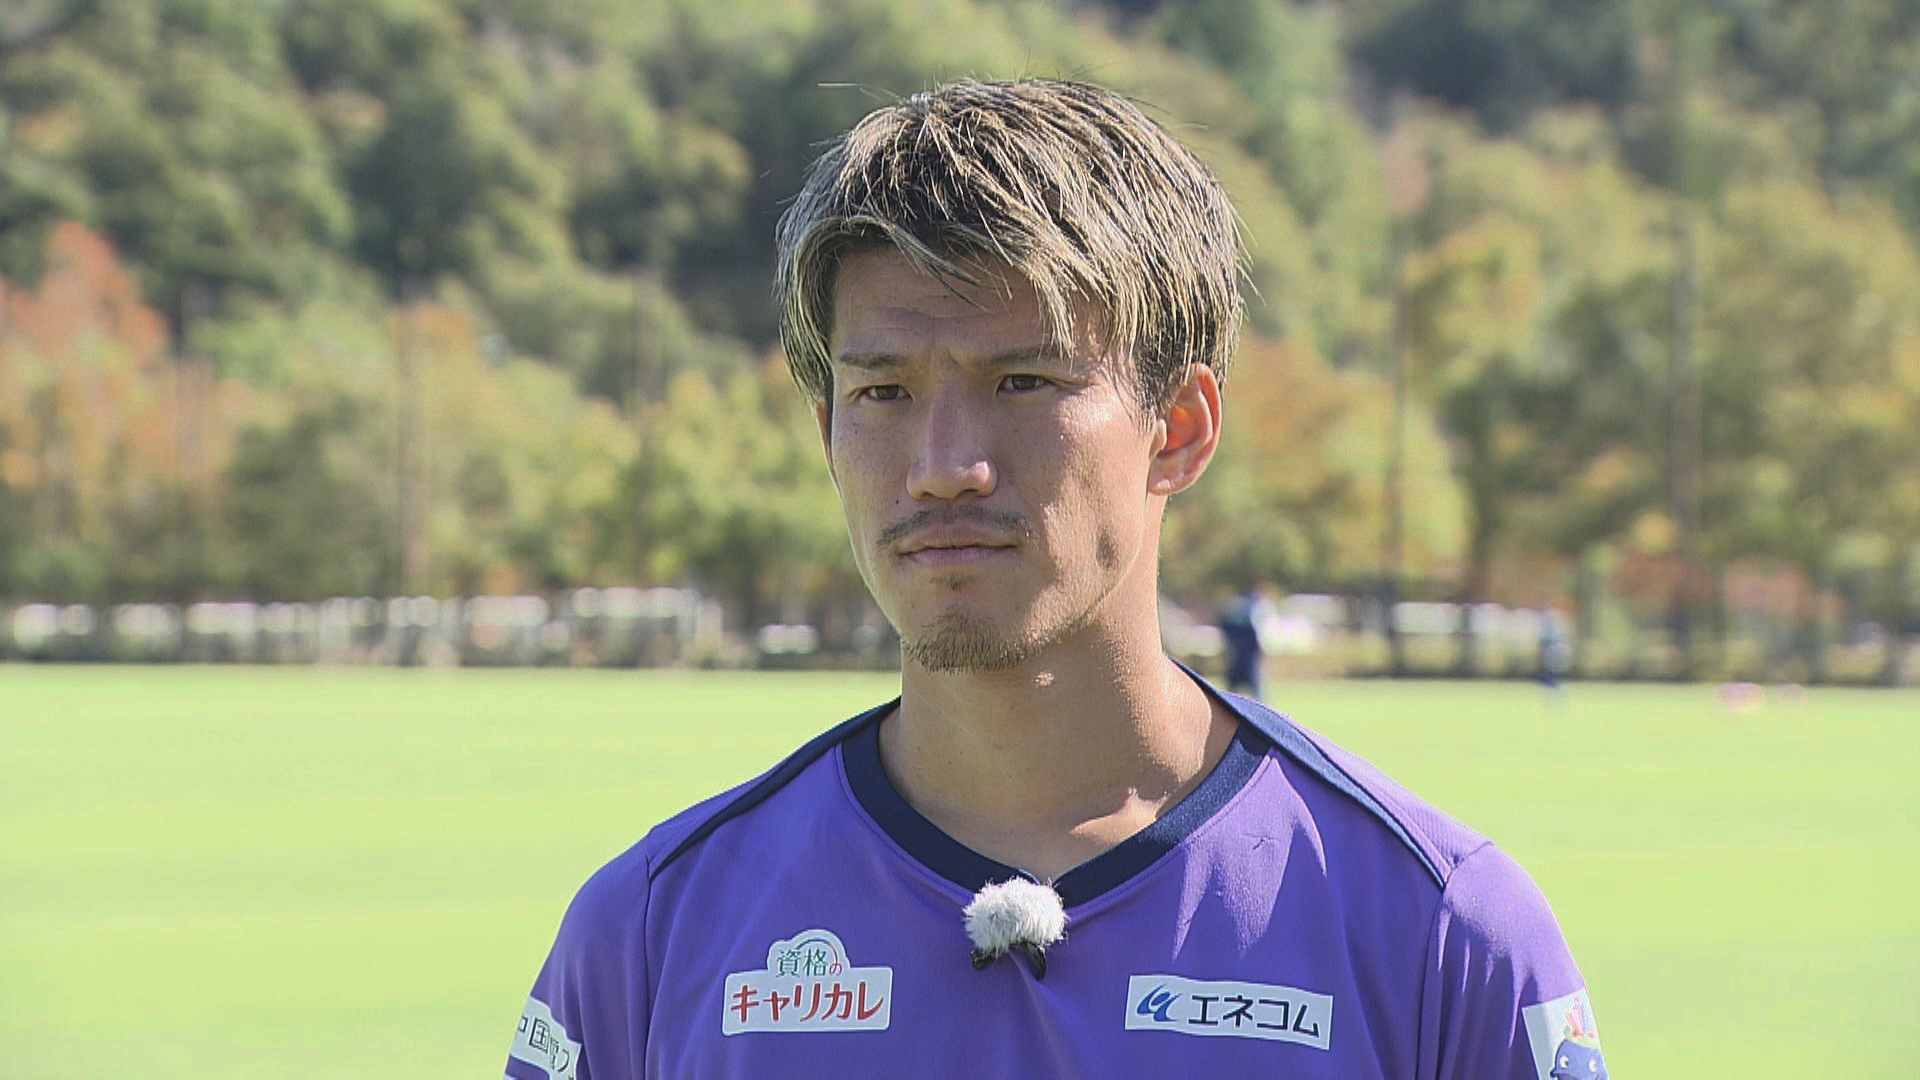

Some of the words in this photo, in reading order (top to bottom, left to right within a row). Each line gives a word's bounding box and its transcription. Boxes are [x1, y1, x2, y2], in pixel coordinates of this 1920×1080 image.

[776, 949, 842, 977] 資格の
[730, 981, 884, 1023] キャリカレ
[1188, 995, 1319, 1038] エネコム
